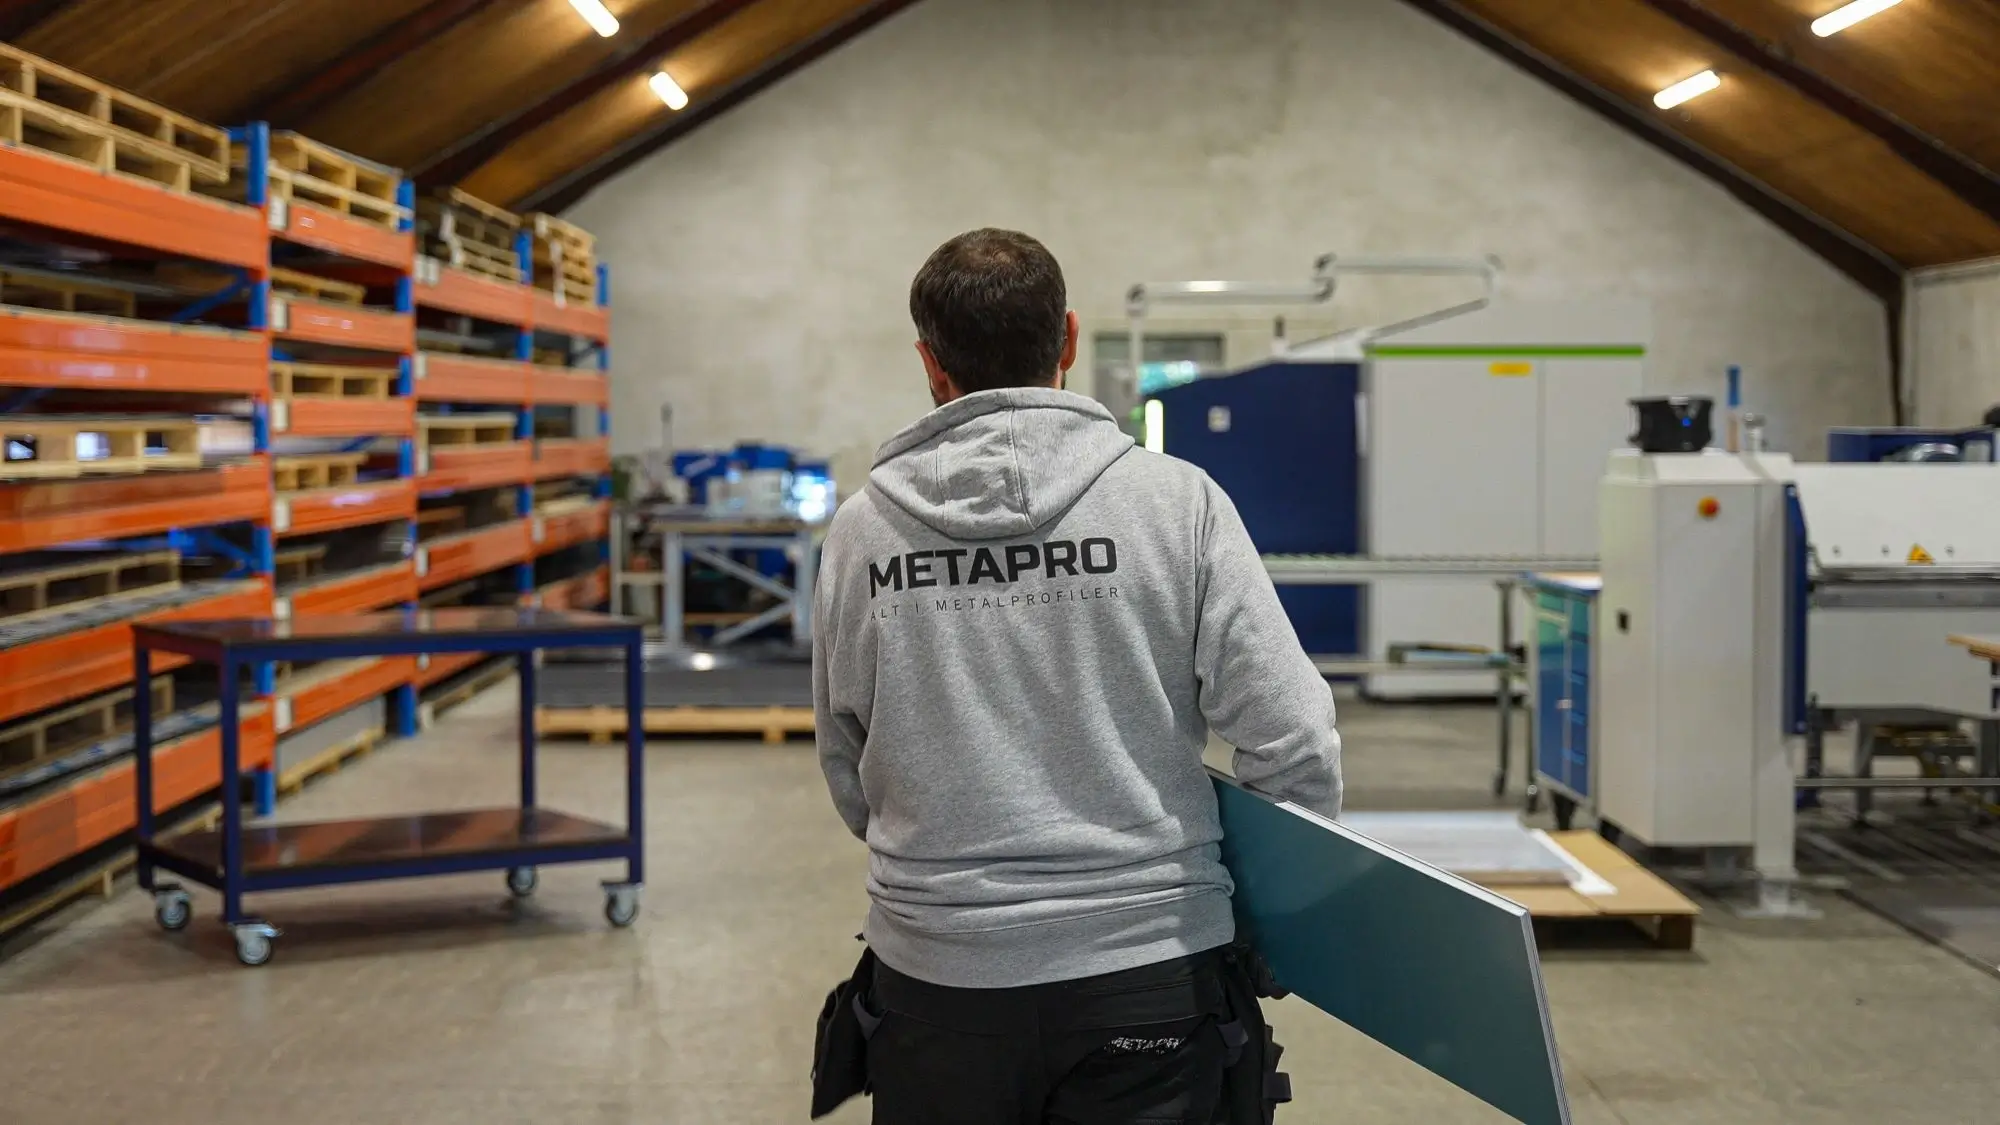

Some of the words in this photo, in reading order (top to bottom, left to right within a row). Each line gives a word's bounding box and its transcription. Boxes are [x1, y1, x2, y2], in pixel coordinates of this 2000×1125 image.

[868, 537, 1117, 599] METAPRO
[870, 605, 900, 622] ALT
[936, 587, 1119, 611] METALPROFILER
